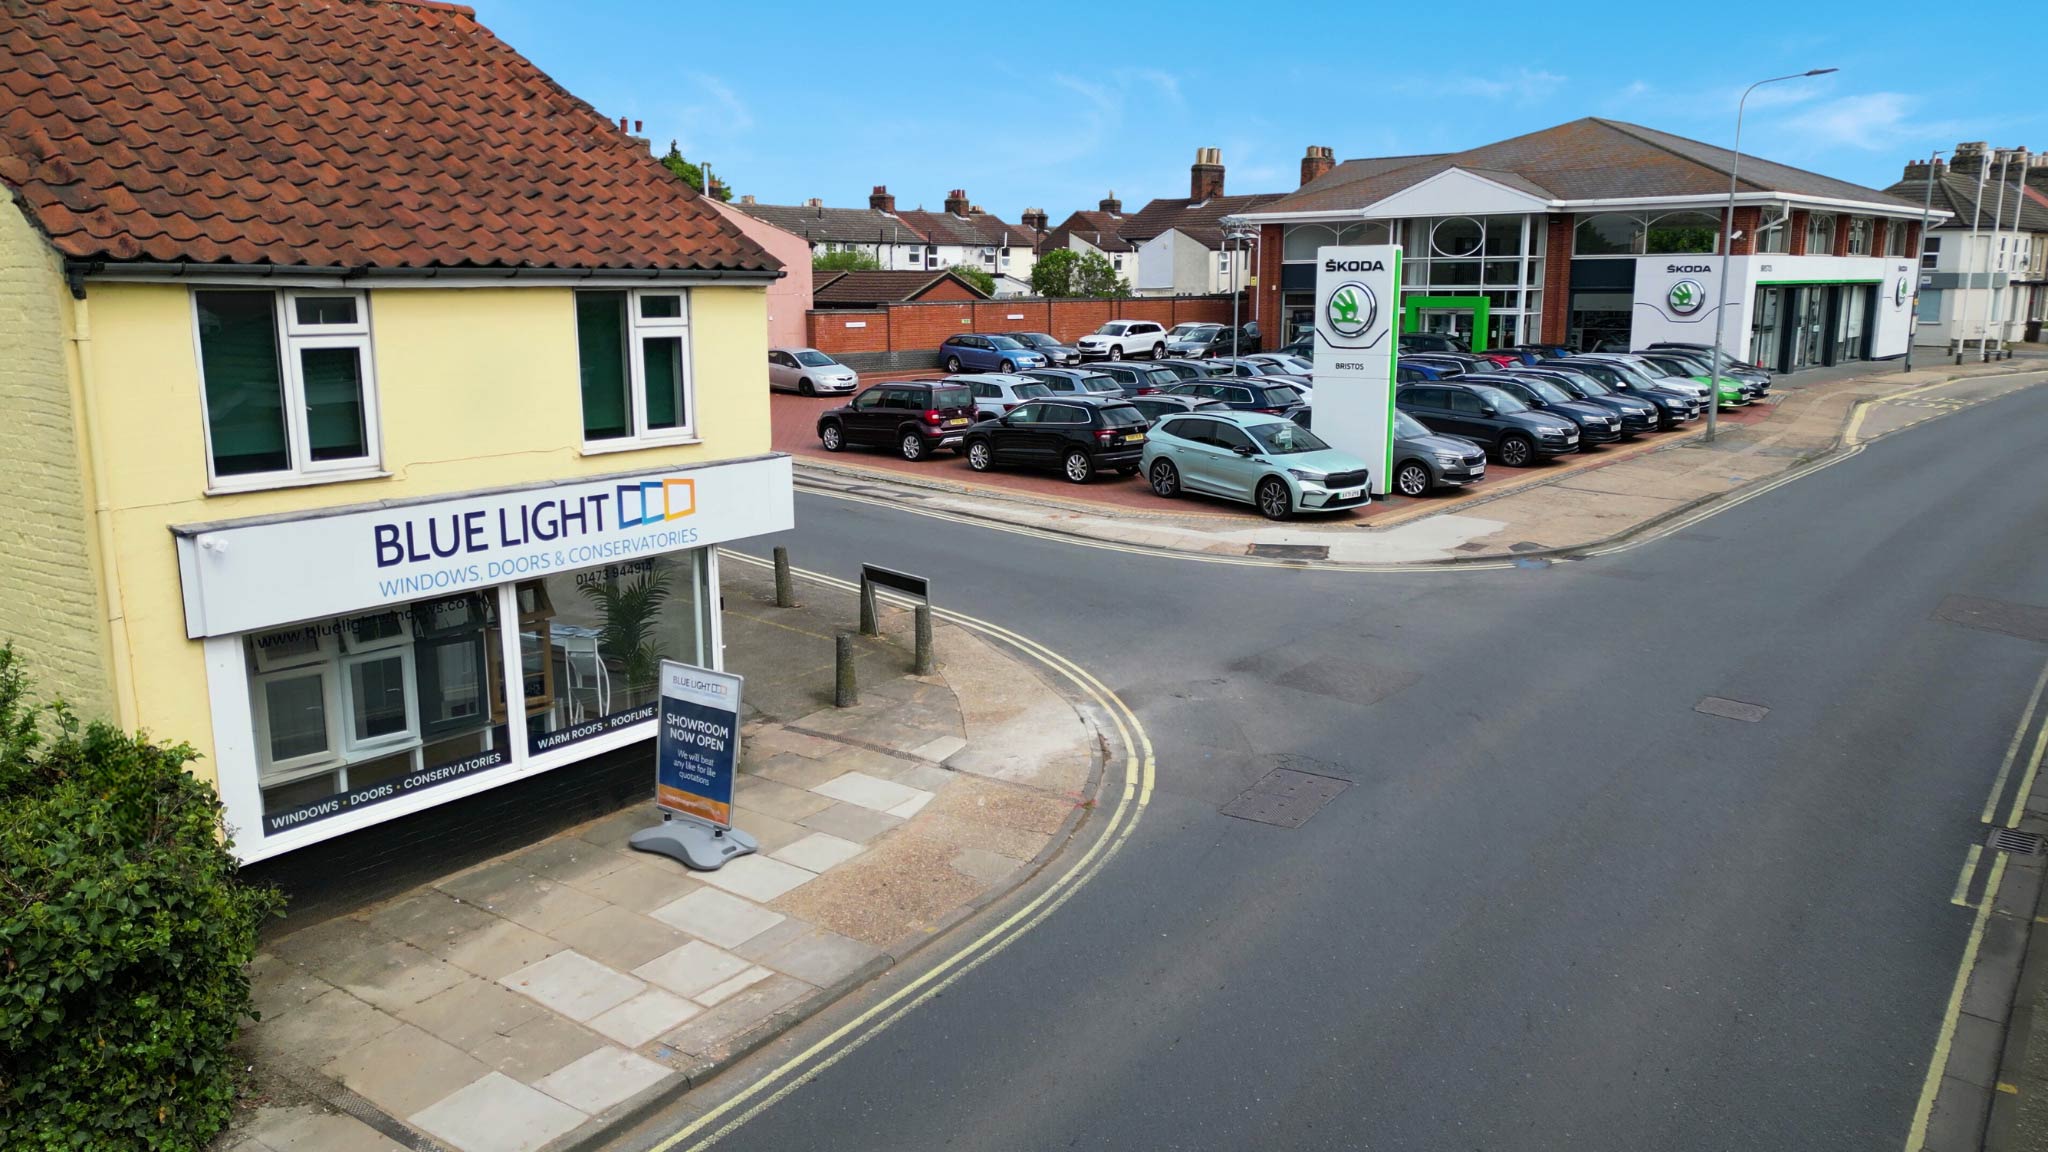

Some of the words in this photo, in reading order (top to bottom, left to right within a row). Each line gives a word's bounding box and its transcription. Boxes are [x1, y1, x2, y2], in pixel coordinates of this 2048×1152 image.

[1325, 259, 1385, 272] ŠKODA
[1666, 264, 1711, 273] ŠKODA
[1335, 362, 1365, 371] BRISTOS
[373, 510, 489, 568] BLUE
[499, 493, 610, 548] LIGHT
[379, 564, 484, 597] WINDOWS,
[487, 552, 551, 578] DOORS
[554, 550, 565, 567] &
[568, 528, 698, 563] CONSERVATORIES
[575, 568, 609, 585] 01473
[257, 590, 490, 649] www.blueligindws.co.
[672, 675, 690, 687] BLUE
[690, 681, 711, 692] LIGHT
[537, 732, 570, 749] WARM
[571, 722, 603, 740] ROOFS
[610, 707, 653, 727] ROOFLINE
[666, 712, 729, 739] SHOWROOM
[670, 727, 695, 744] NOW
[696, 734, 724, 752] OPEN
[673, 759, 685, 769] any
[685, 760, 696, 771] like
[697, 764, 706, 774] for
[677, 749, 688, 760] We
[689, 753, 700, 762] will
[700, 755, 714, 767] beat
[678, 771, 710, 786] quotations
[271, 800, 339, 829] WINDOWS
[350, 784, 394, 806] DOORS
[403, 752, 502, 790] CONSERVATORIES
